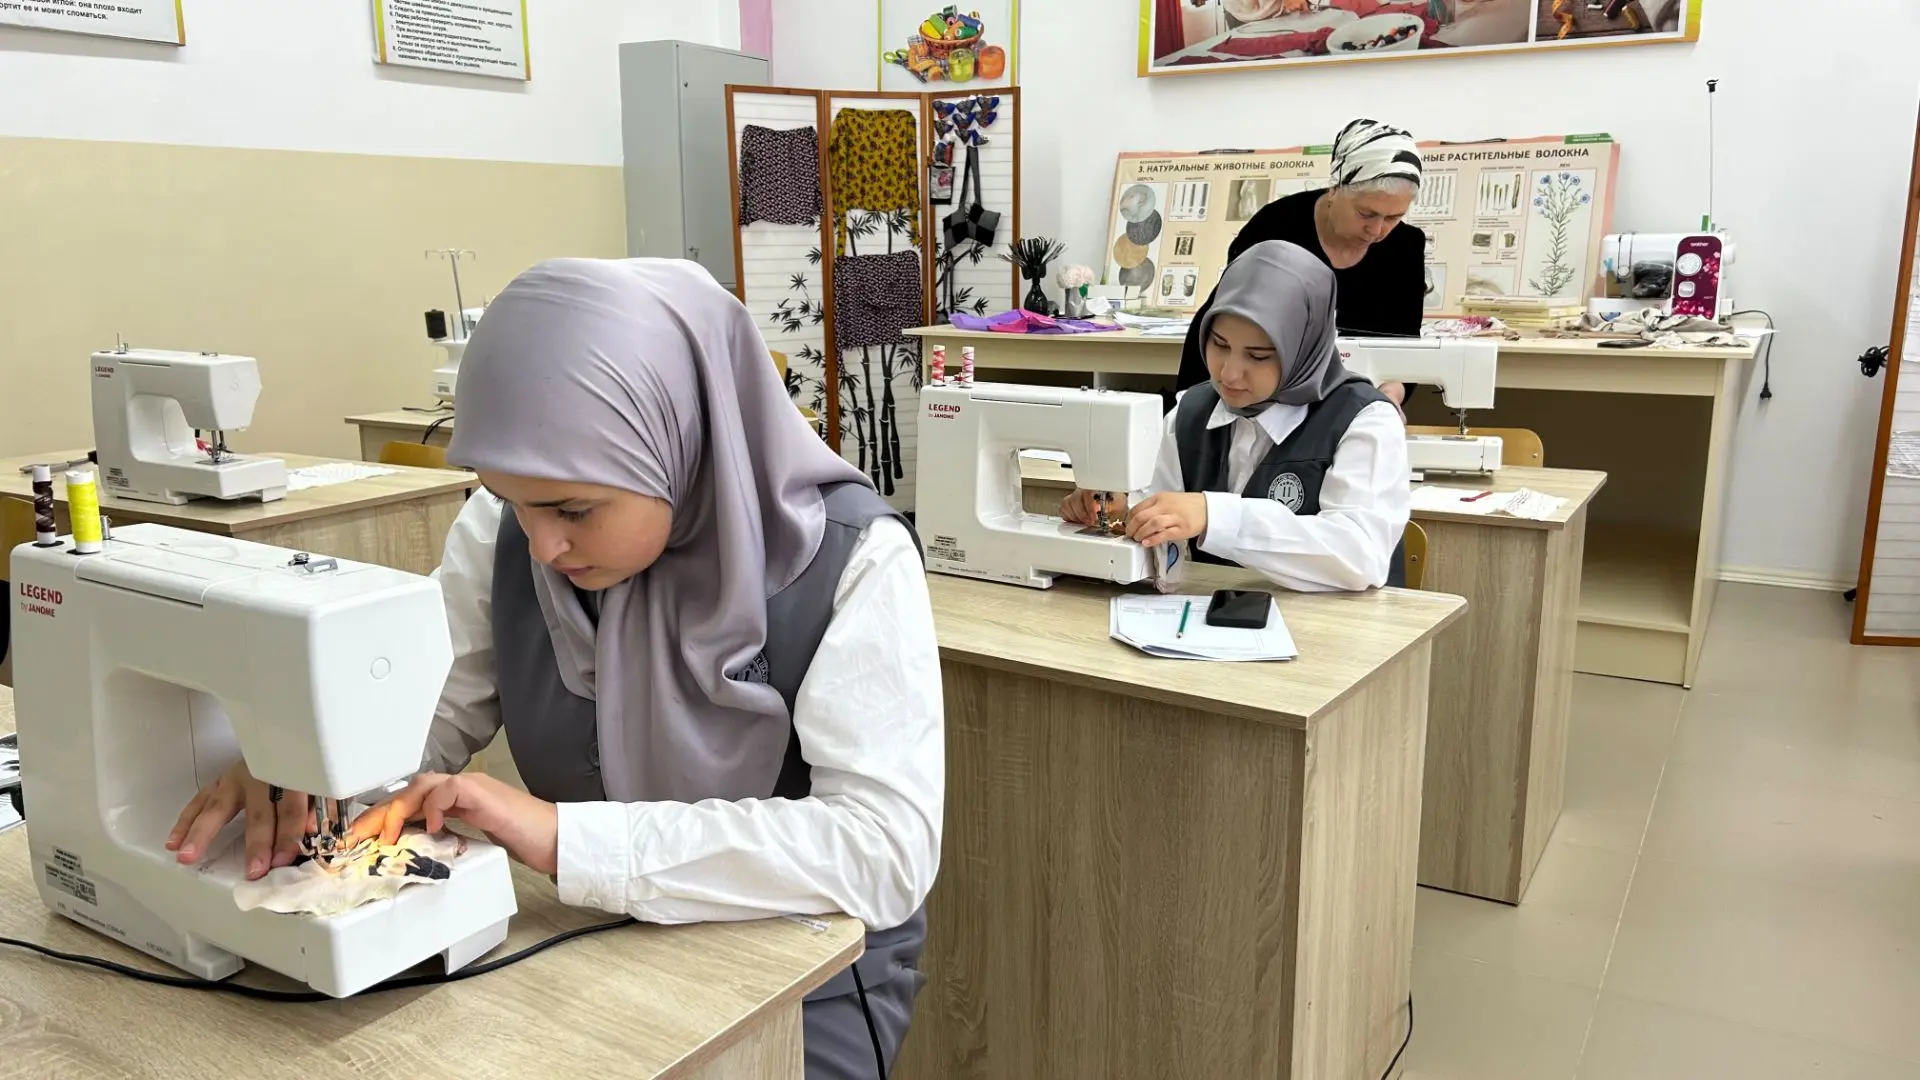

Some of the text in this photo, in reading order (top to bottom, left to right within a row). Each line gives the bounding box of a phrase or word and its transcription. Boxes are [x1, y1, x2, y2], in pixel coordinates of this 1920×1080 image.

[66, 10, 108, 20] сломаться.
[117, 6, 142, 14] входит
[1447, 150, 1530, 161] РАСТИТЕЛЬНЫЕ
[1536, 148, 1589, 158] ВОЛОКНА
[1138, 160, 1315, 174] 3. НАТУРАЛЬНЫЕ ЖИВОТНЫЕ ВОЛОКНА
[928, 404, 961, 413] LEGEND
[20, 582, 62, 605] LEGEND
[28, 603, 56, 618] JANOME
